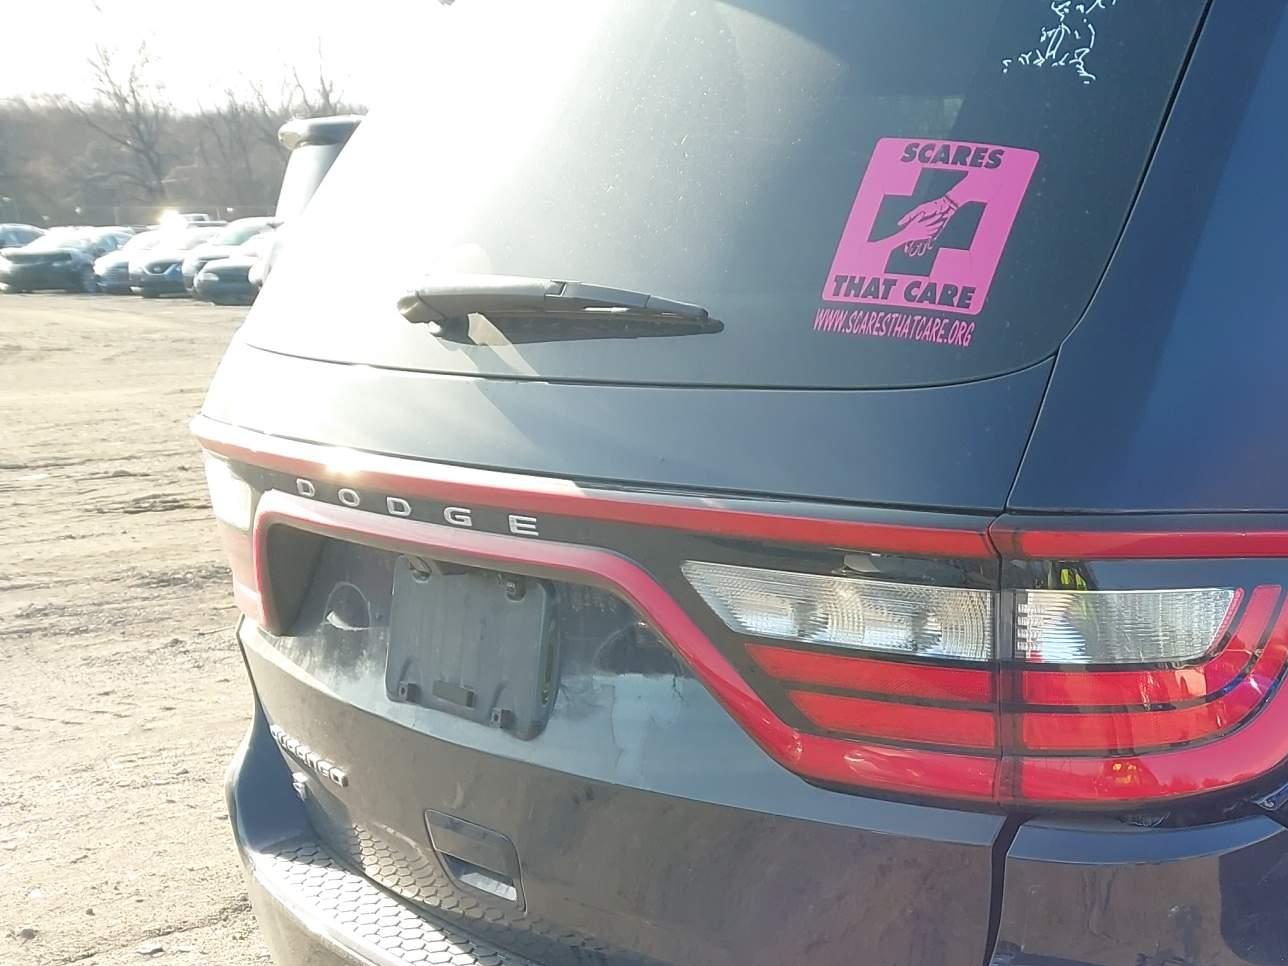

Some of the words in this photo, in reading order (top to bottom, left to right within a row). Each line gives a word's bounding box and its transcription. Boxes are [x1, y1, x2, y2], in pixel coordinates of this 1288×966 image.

[901, 142, 1005, 169] SCARES
[832, 275, 898, 301] THAT
[904, 280, 977, 309] CARE
[813, 308, 976, 347] WWW.SCARESTHATCARE.ORG
[295, 477, 541, 537] DODGE
